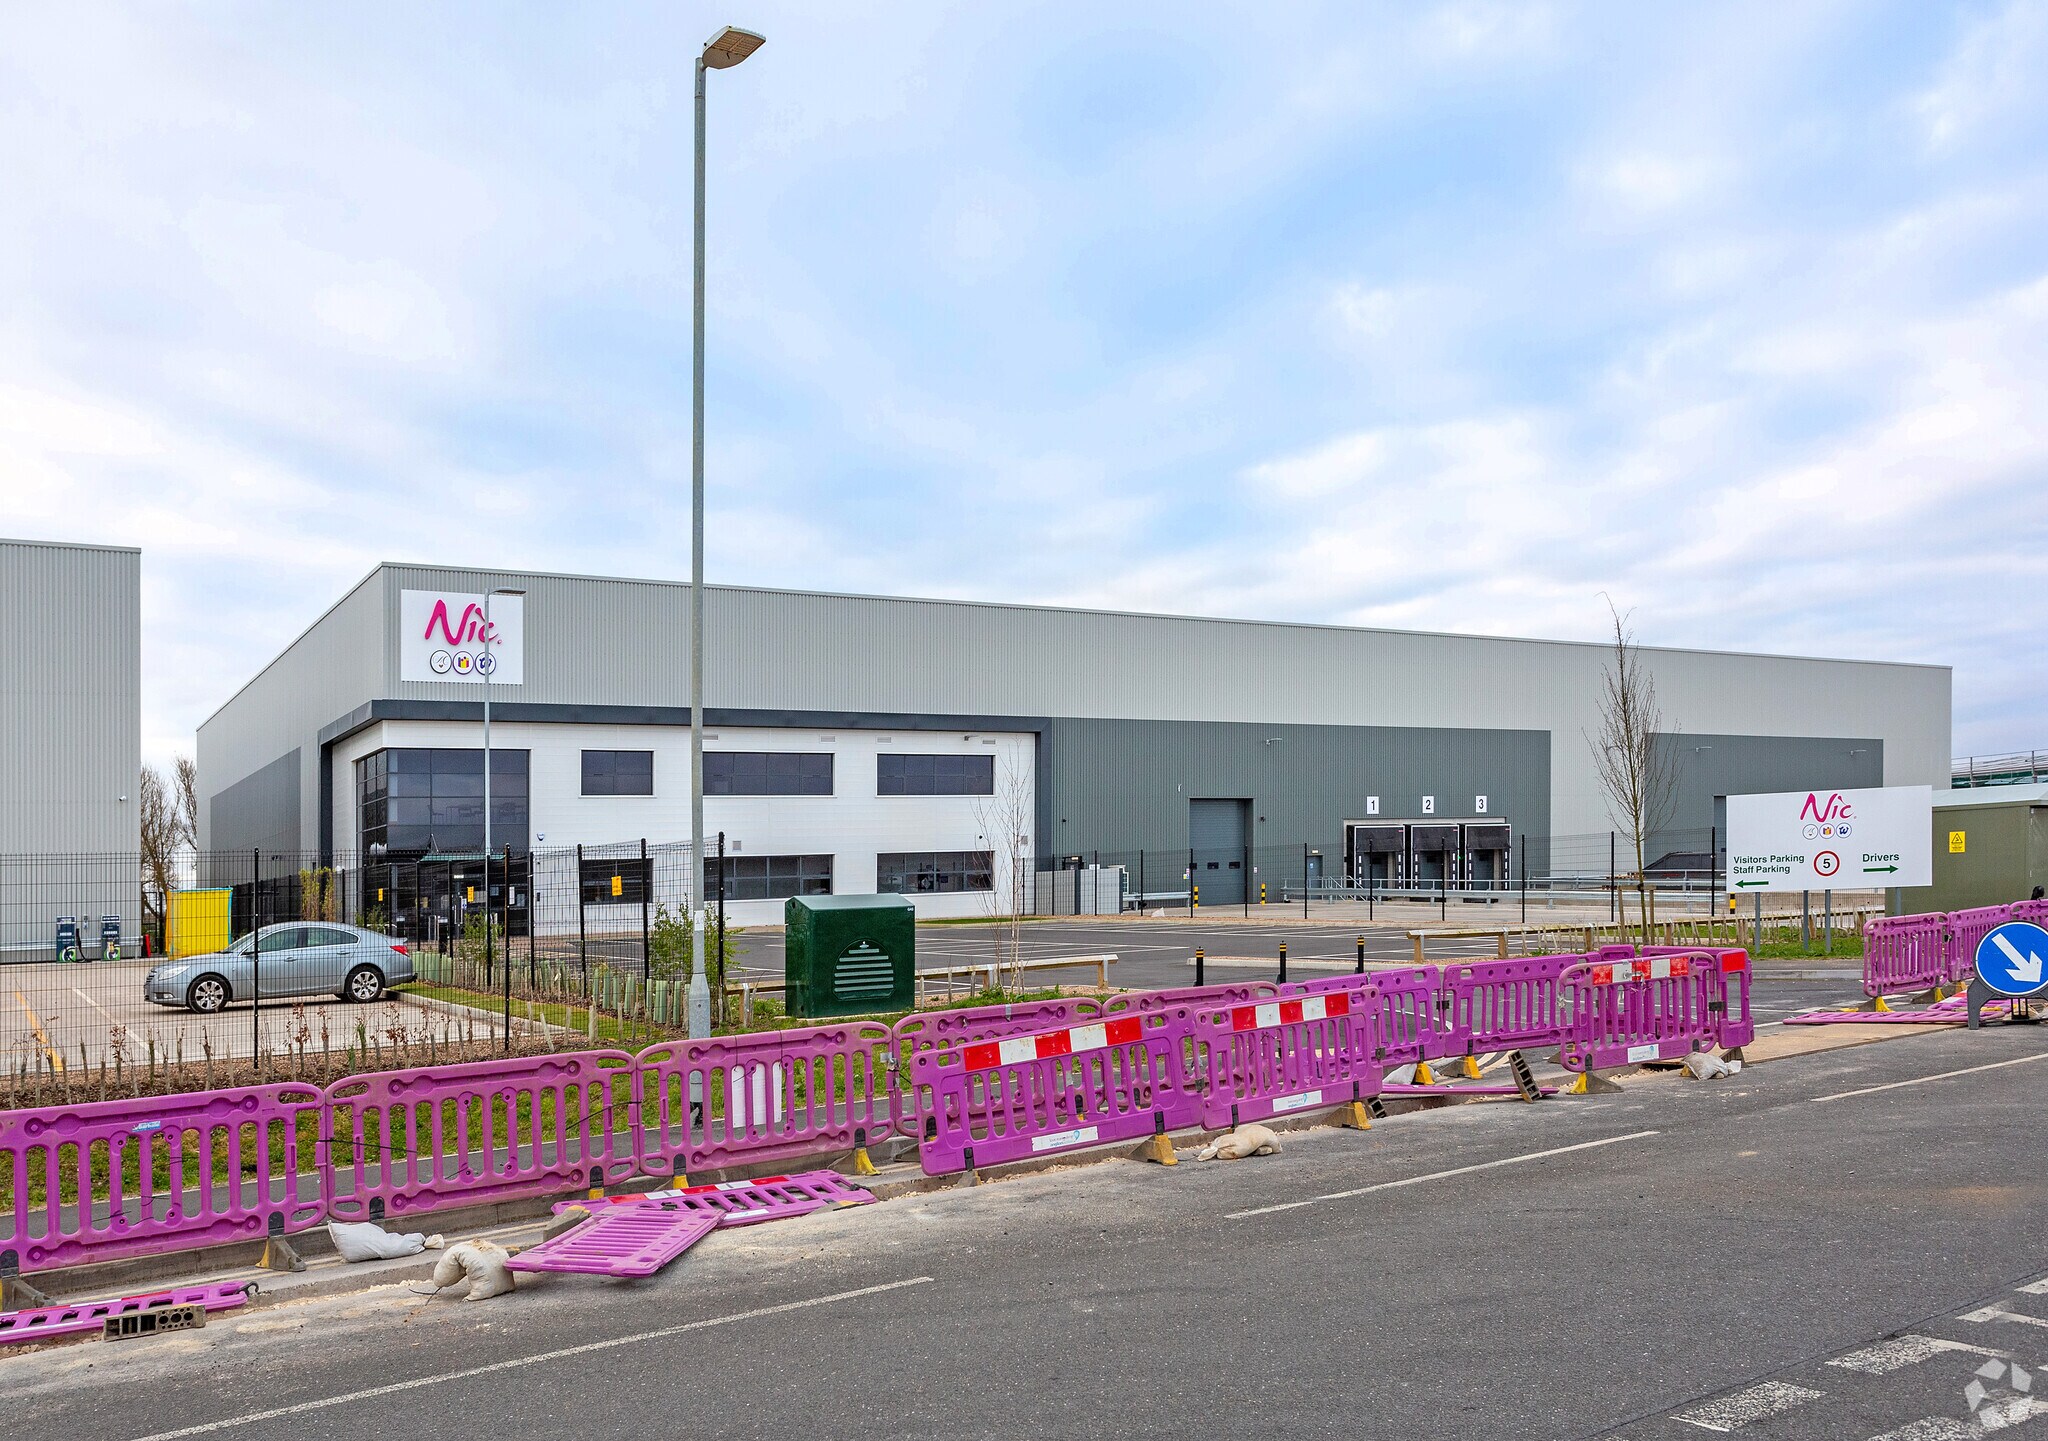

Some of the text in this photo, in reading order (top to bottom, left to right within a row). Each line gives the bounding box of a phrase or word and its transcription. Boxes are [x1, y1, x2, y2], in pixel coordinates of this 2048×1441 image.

[1371, 800, 1375, 810] 1
[1425, 800, 1431, 810] 2
[1478, 799, 1484, 809] 3
[1799, 792, 1855, 823] Nic
[1733, 854, 1805, 864] Visitors Parking
[1862, 853, 1900, 863] Drivers
[1822, 858, 1831, 869] 5
[1733, 865, 1791, 875] Staff Parking
